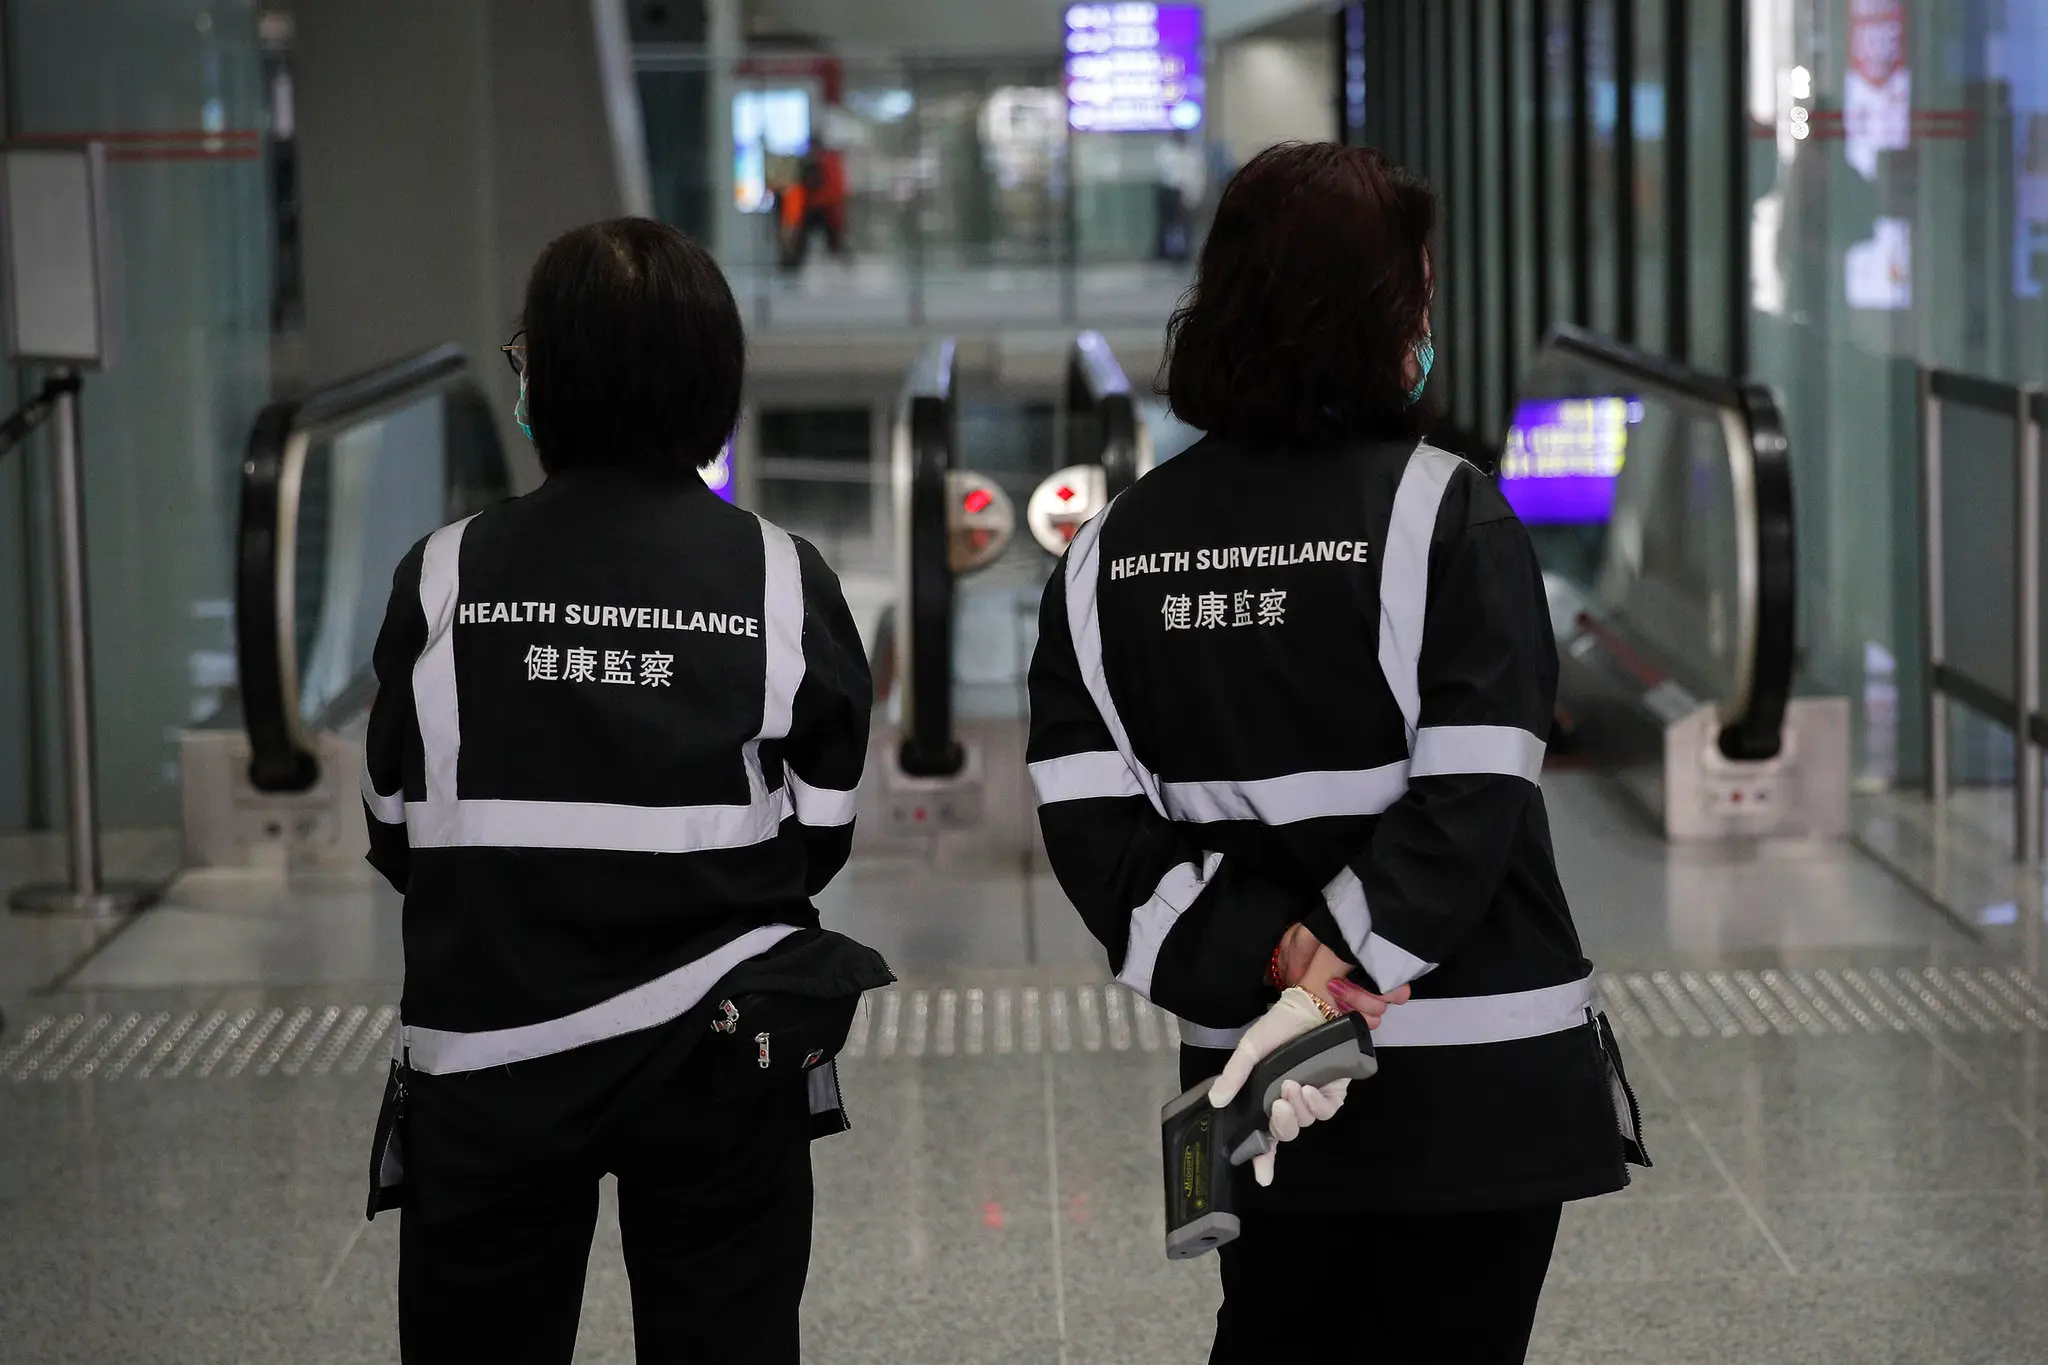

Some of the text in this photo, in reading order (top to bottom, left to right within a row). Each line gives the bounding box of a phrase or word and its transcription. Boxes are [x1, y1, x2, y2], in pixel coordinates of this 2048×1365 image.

[1110, 540, 1370, 581] HEALTH SURVEILLANCE
[459, 601, 760, 638] HEALTH SURVEILLANCE
[1160, 587, 1288, 632] 健康監察
[523, 644, 675, 688] 健康監察
